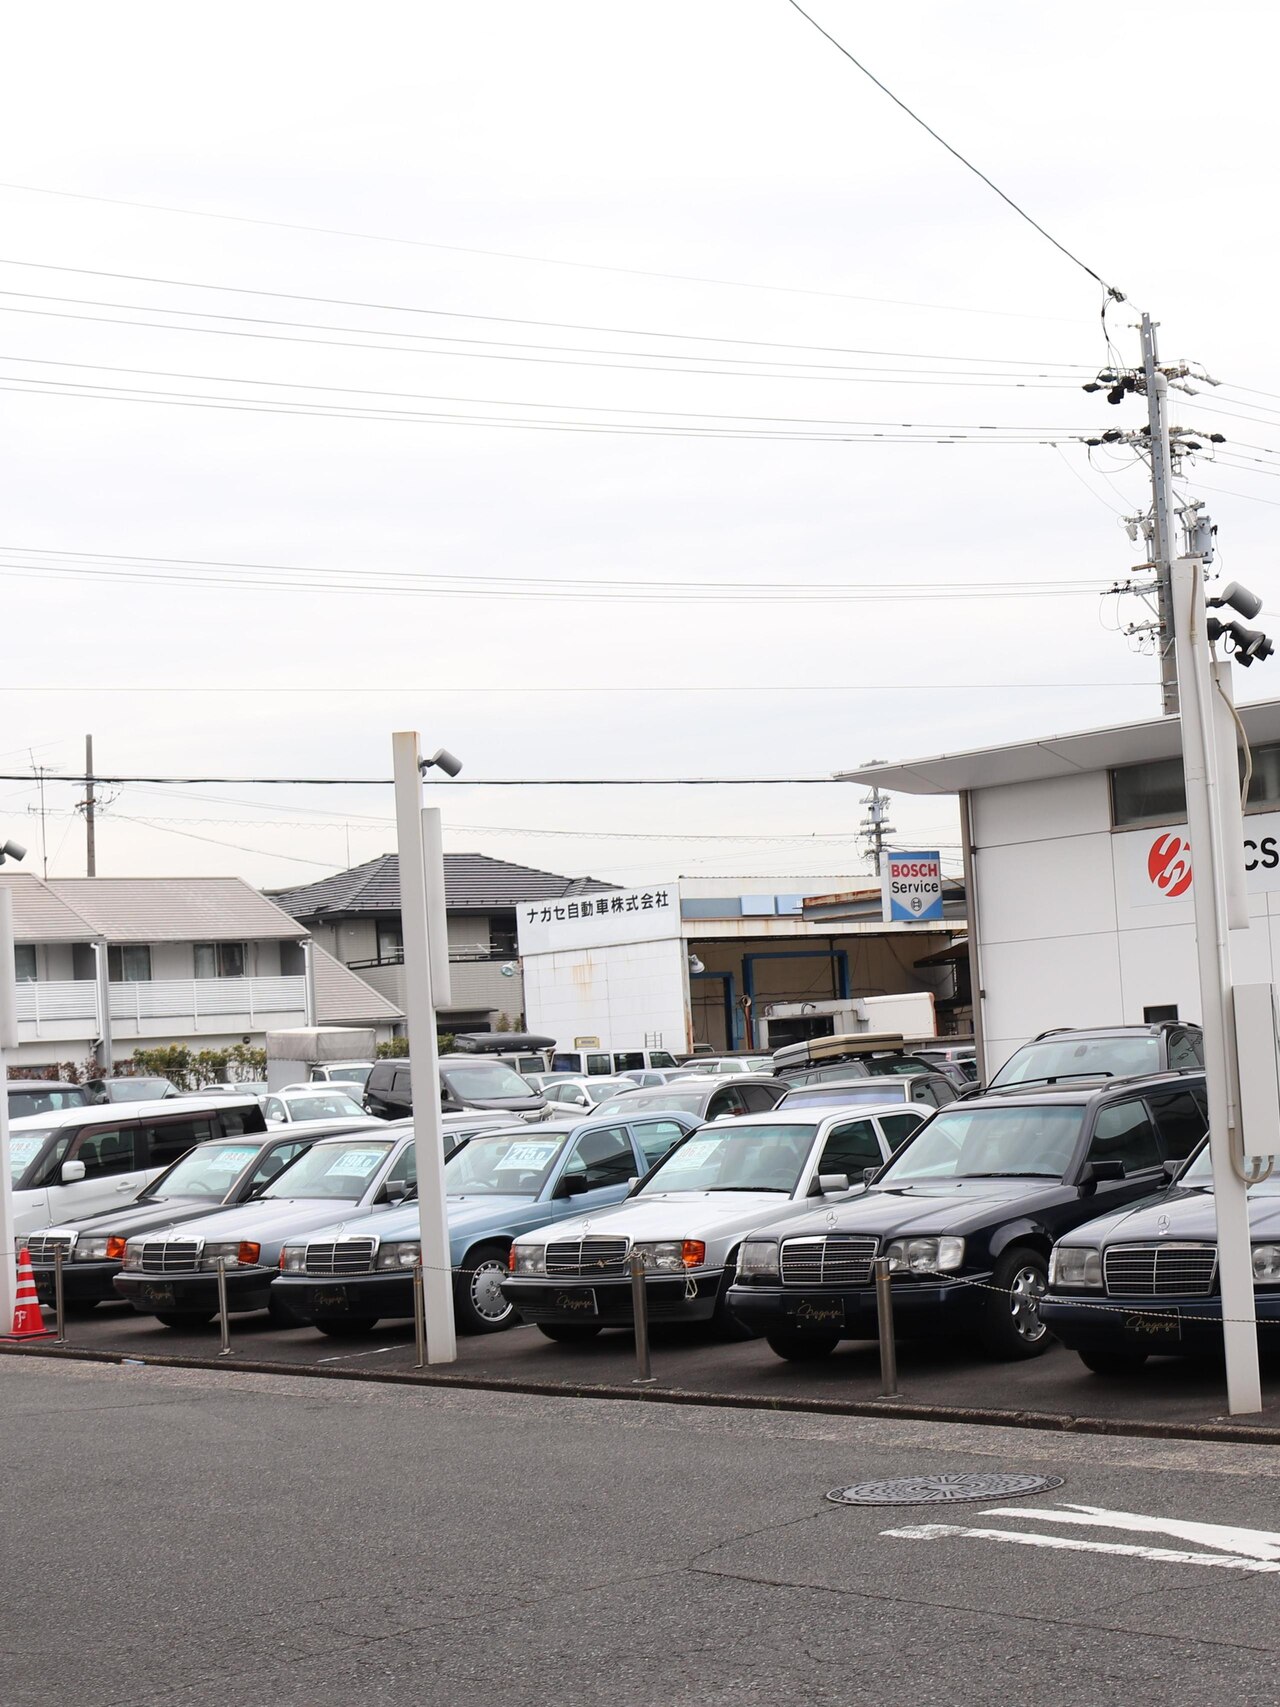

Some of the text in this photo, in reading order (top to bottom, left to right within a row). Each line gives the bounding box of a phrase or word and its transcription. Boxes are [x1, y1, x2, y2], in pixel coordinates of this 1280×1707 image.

[891, 863, 938, 877] BOSCH
[891, 880, 939, 893] Service
[526, 890, 669, 924] ナガセ自動車株式会社
